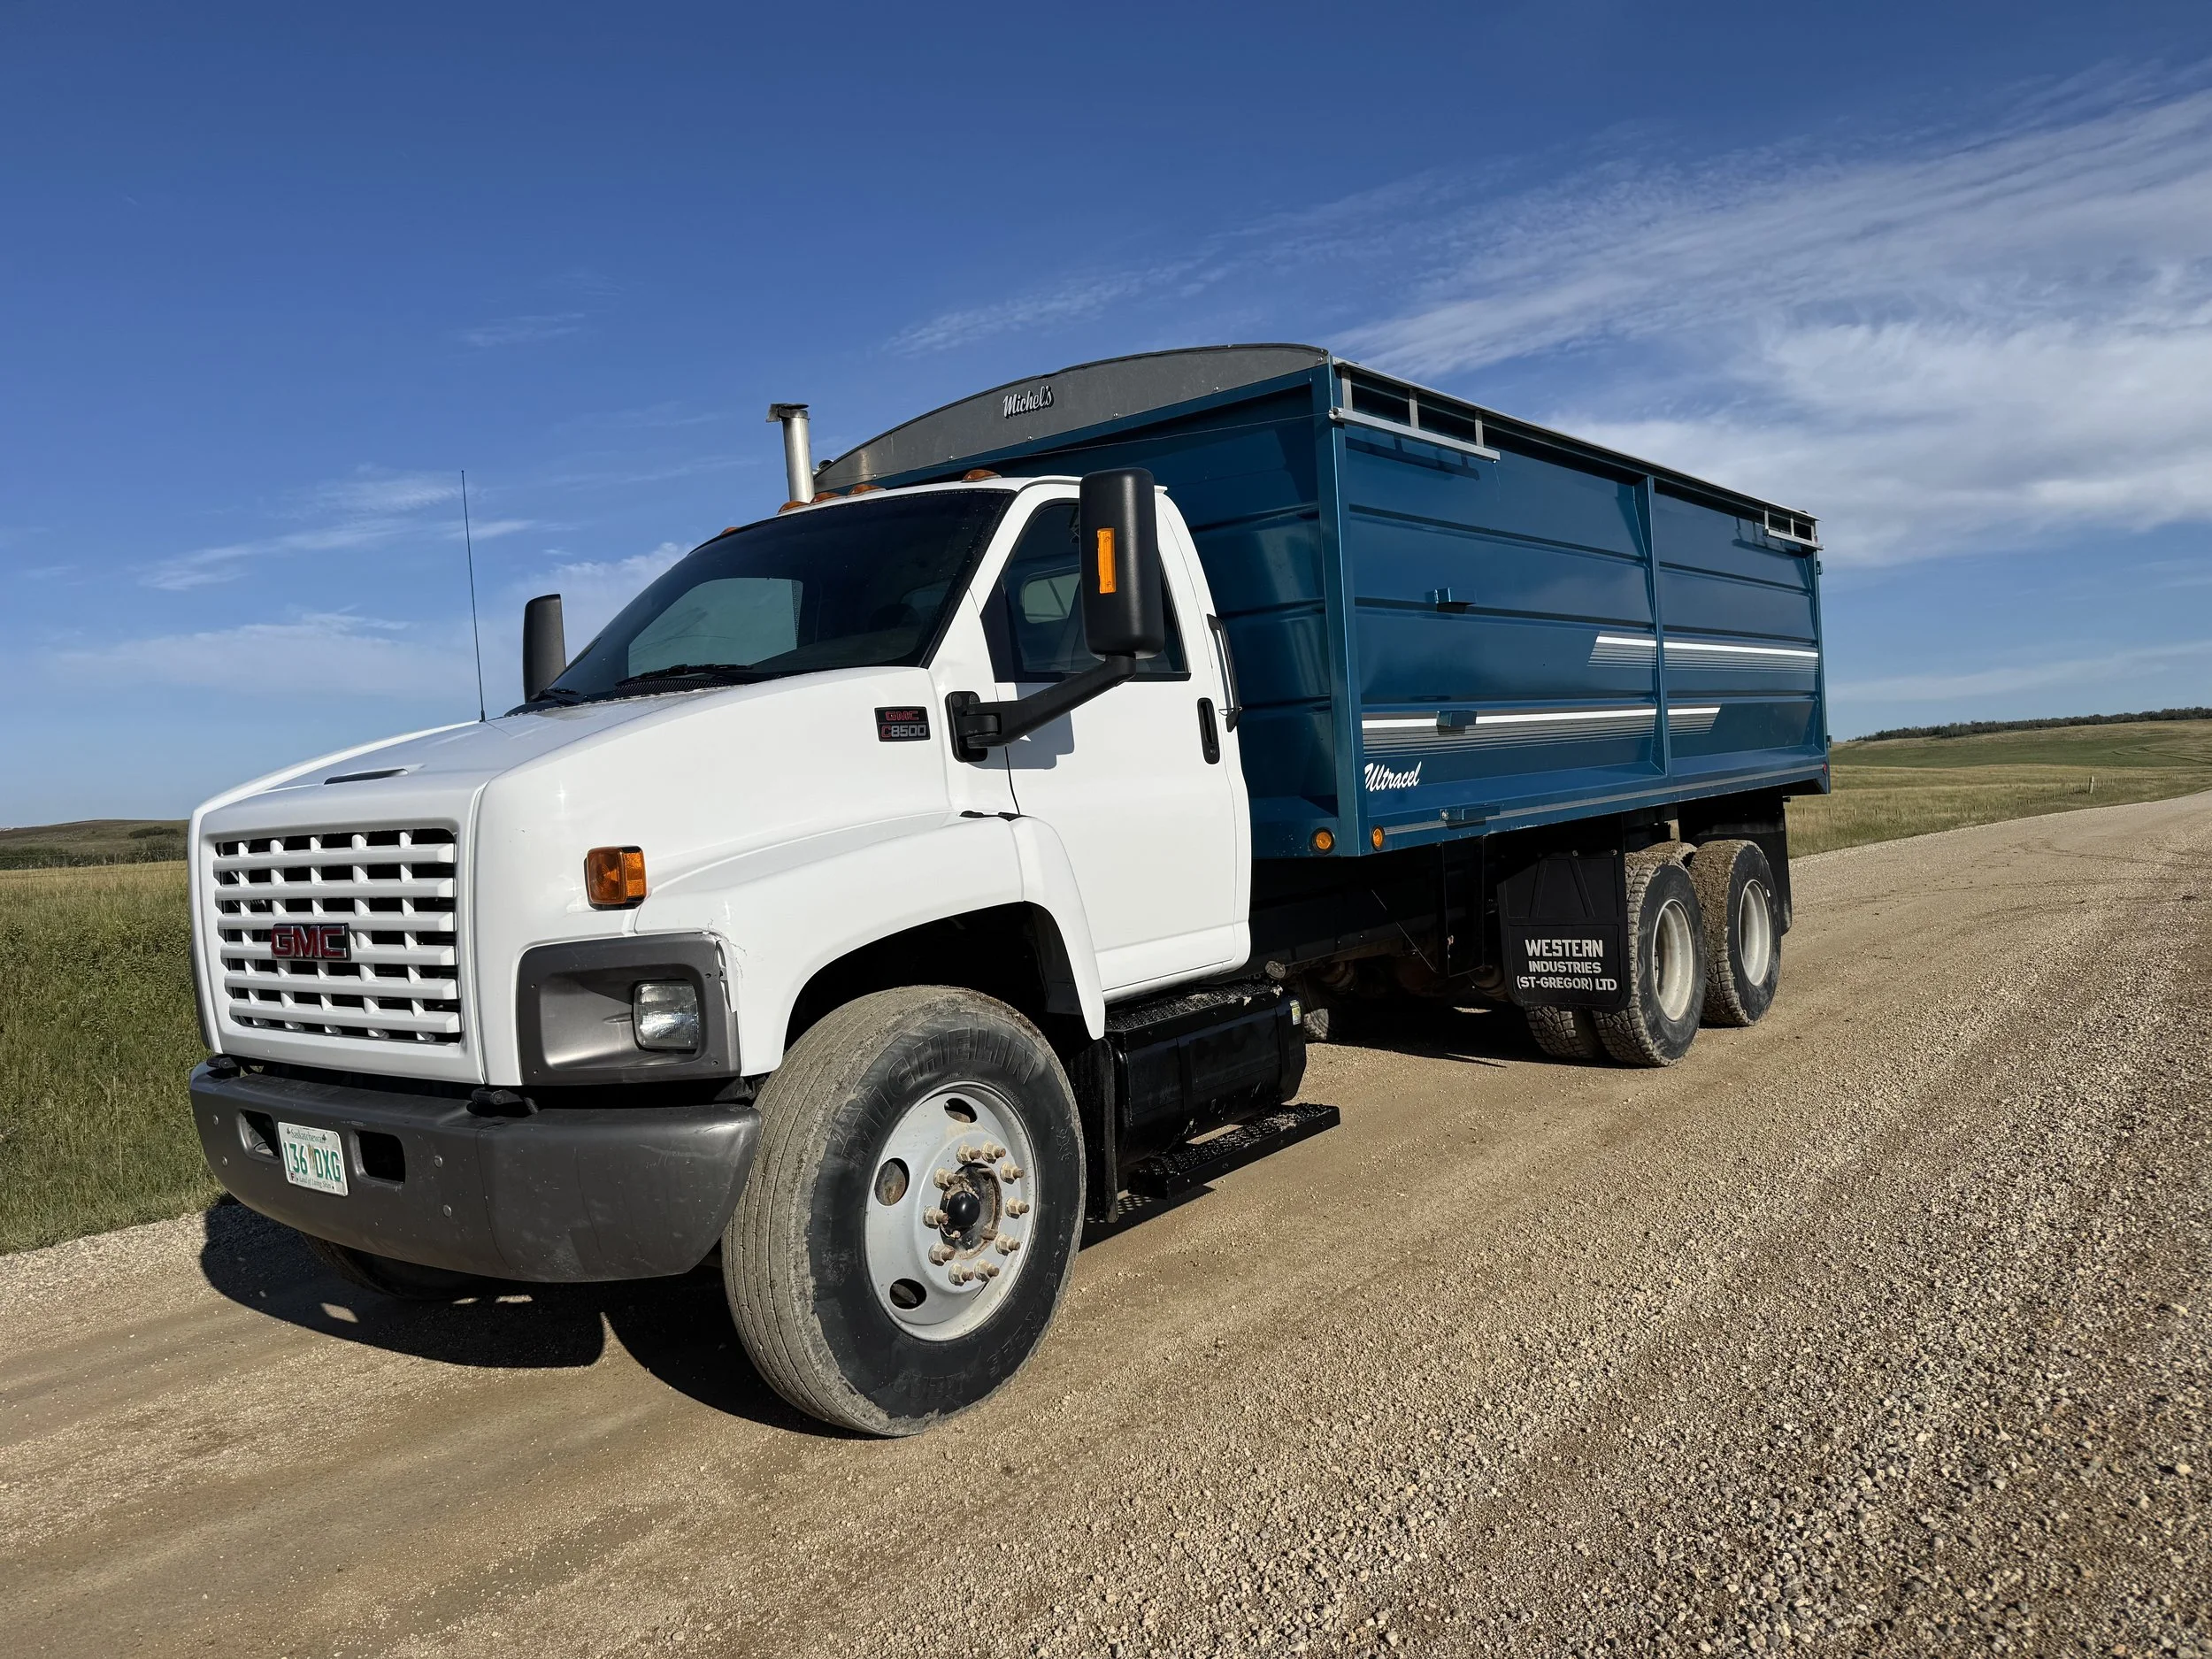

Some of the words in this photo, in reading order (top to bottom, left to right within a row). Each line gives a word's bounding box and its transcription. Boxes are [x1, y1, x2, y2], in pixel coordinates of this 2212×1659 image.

[1002, 385, 1053, 418] Michel's
[886, 710, 919, 721] GMC
[881, 724, 926, 738] C8500
[1364, 761, 1422, 792] Ultracel
[271, 925, 347, 959] GMC
[1525, 939, 1603, 957] WESTERN
[1528, 960, 1601, 974] INDUSTRIES
[1517, 975, 1593, 991] (ST-GREGOR)
[1595, 978, 1617, 991] LTD
[841, 1026, 1036, 1167] MICHELIN
[283, 1141, 308, 1175] 136
[313, 1148, 342, 1182] DXG
